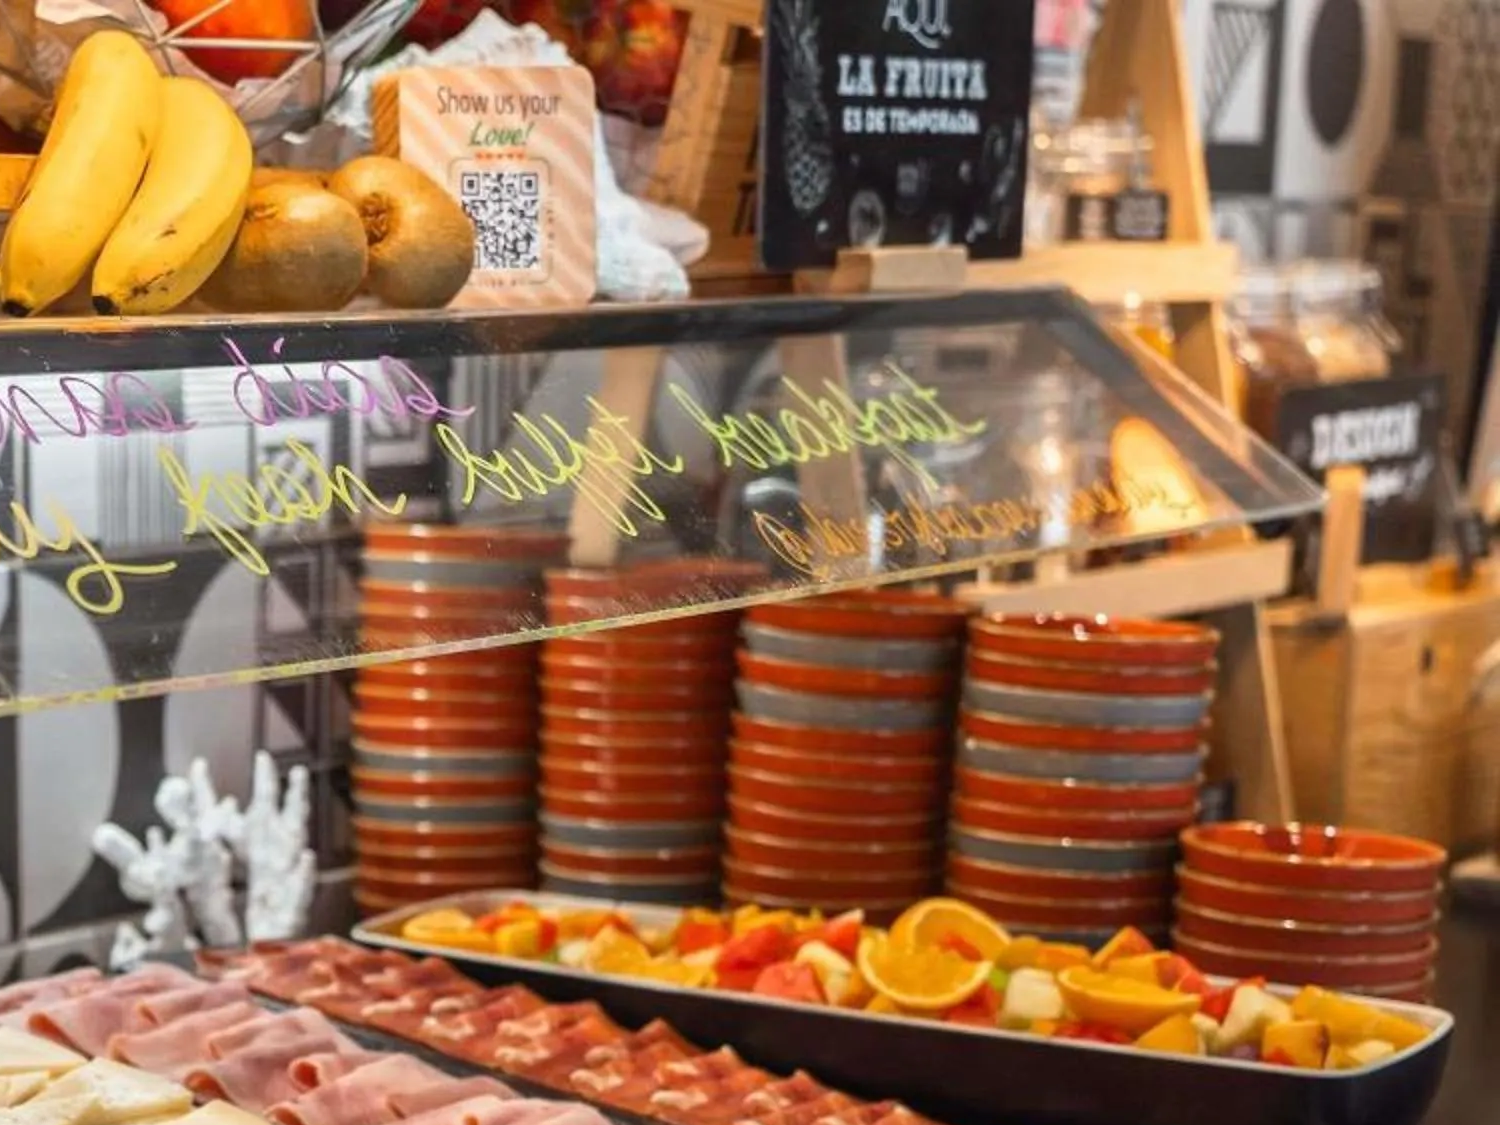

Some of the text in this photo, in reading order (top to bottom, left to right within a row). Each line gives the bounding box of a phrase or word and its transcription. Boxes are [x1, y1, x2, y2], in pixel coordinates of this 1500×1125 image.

[837, 54, 988, 100] LA FRUITA
[437, 86, 562, 122] Show us your
[468, 121, 535, 147] Love!
[157, 433, 407, 576] fresh
[436, 394, 684, 537] buffet
[667, 360, 987, 490] breakfast
